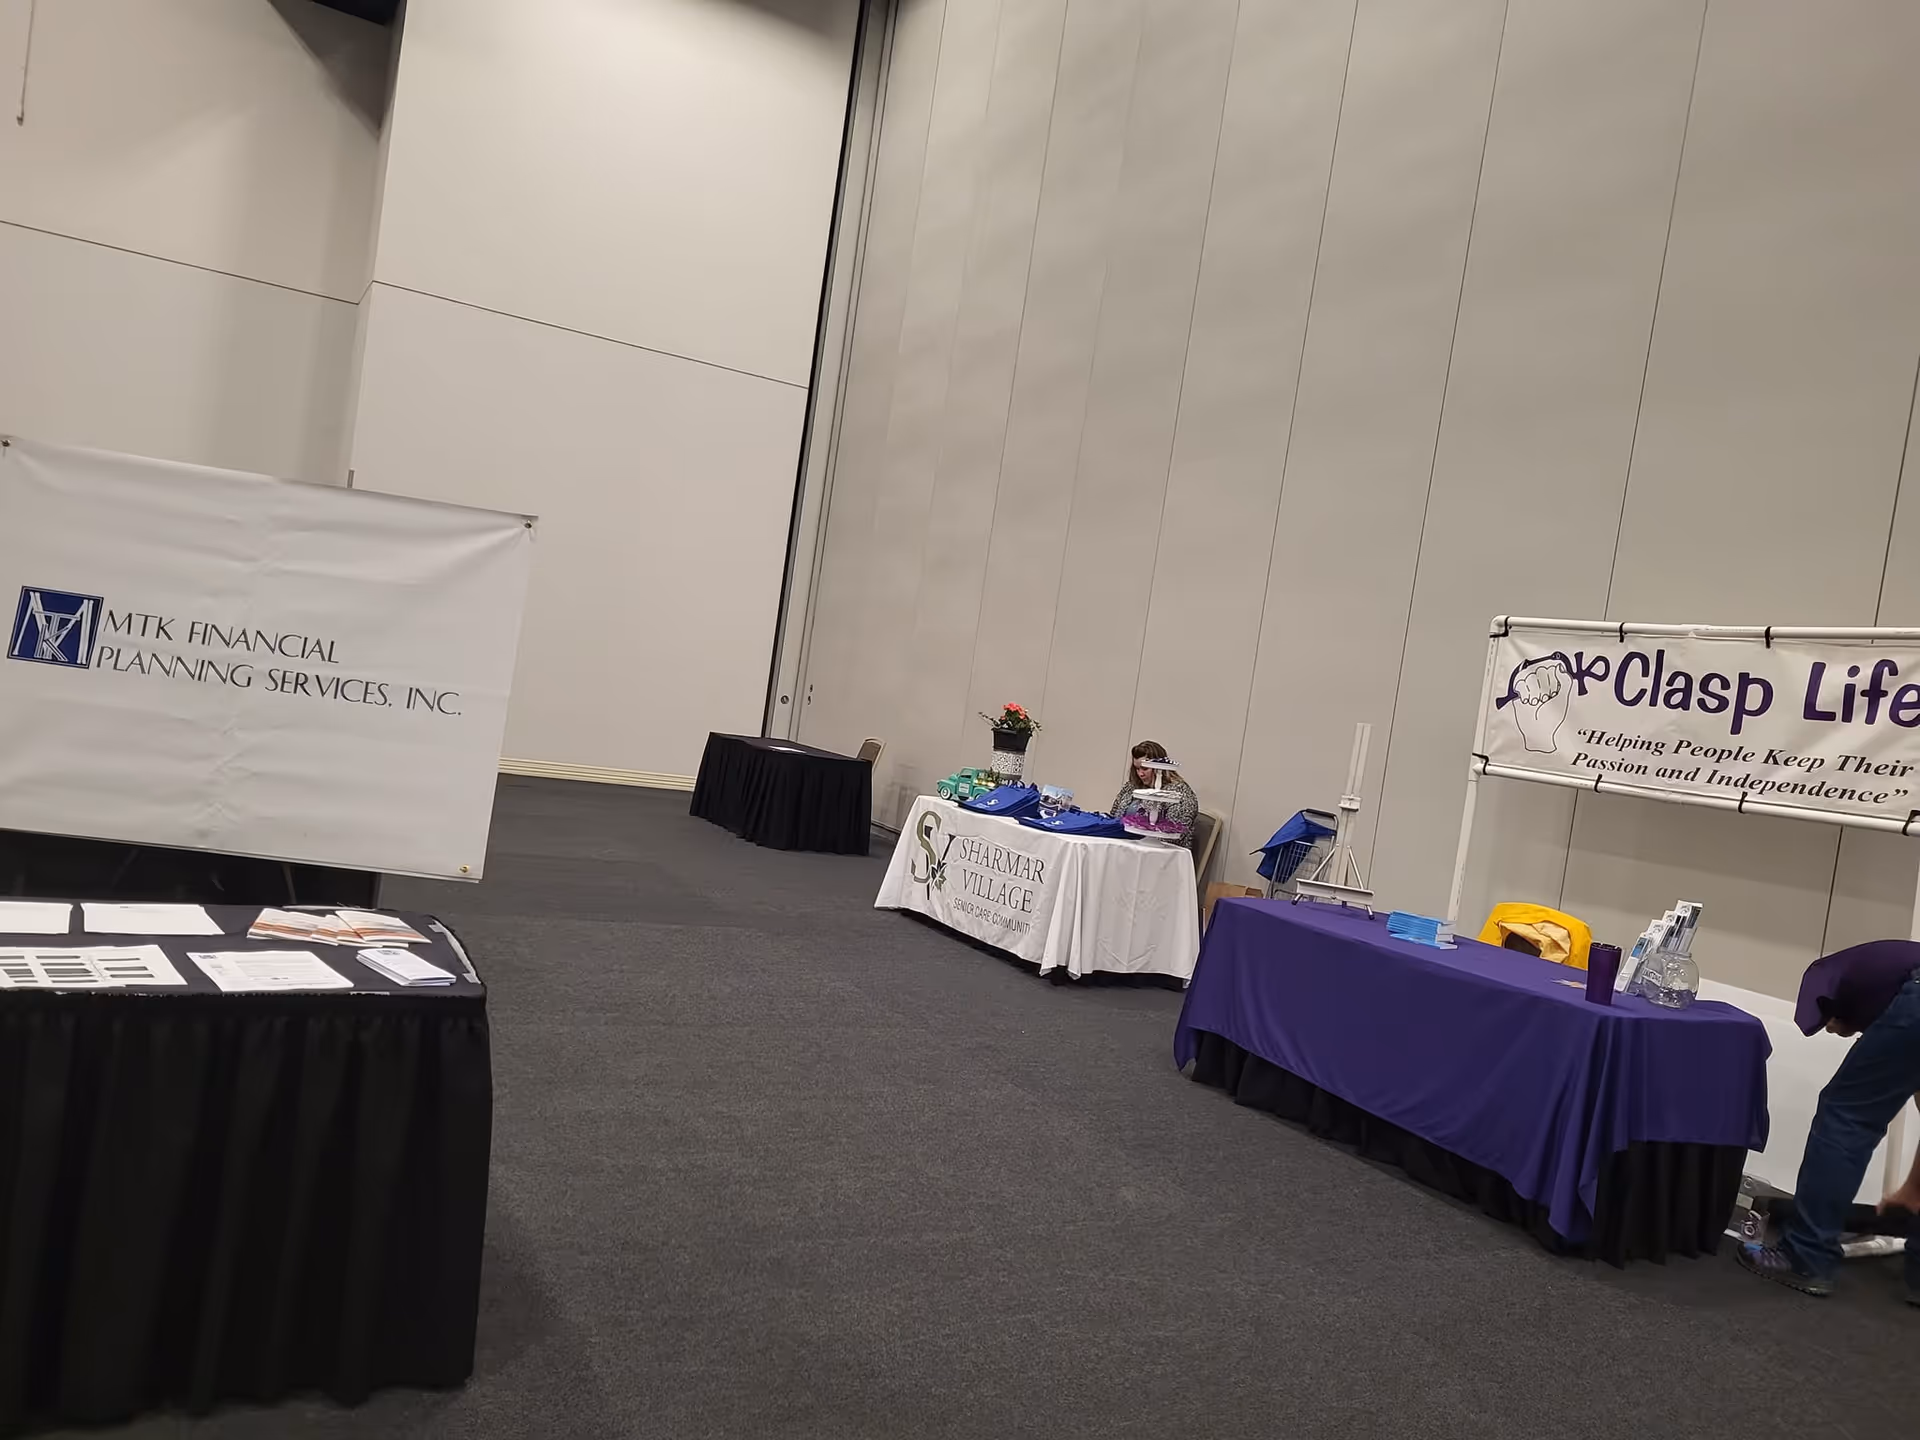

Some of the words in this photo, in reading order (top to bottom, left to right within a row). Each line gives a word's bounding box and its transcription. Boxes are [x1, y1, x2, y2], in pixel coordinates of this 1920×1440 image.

[103, 609, 175, 642] MTK
[188, 620, 340, 664] FINANCIAL
[96, 645, 252, 689] PLANNING
[405, 686, 463, 716] INC.
[1614, 649, 1774, 735] Clasp
[1802, 659, 1920, 728] Life
[1571, 752, 1648, 777] Passion
[1655, 765, 1701, 783] and
[1705, 769, 1908, 805] Independence”
[1577, 728, 1667, 757] “Helping
[1673, 739, 1756, 765] People
[1762, 748, 1825, 773] Keep
[1836, 754, 1914, 779] Their
[959, 837, 1045, 884] SHARMAR
[962, 868, 1034, 914] VILLAGE
[975, 905, 992, 923] CARE
